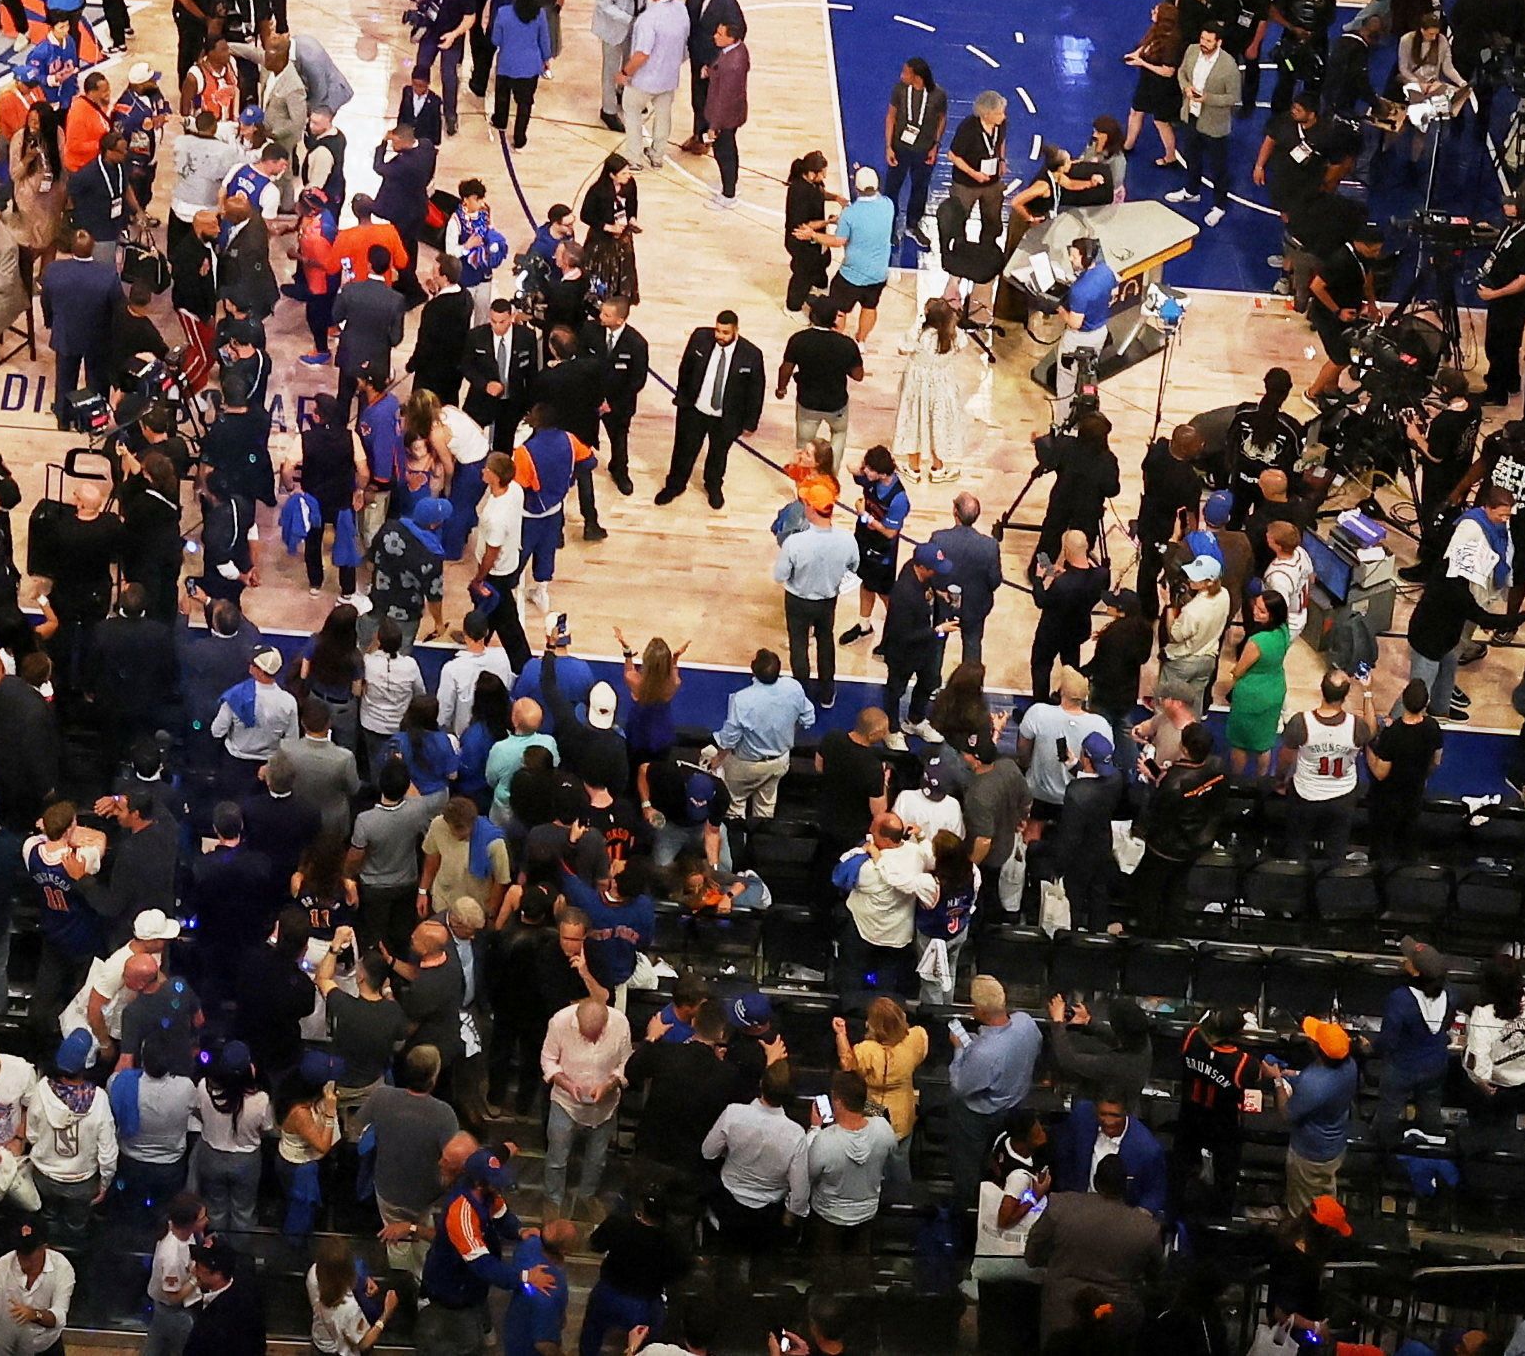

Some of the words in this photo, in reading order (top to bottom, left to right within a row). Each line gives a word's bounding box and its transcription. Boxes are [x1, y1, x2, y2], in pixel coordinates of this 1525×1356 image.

[1318, 756, 1344, 779] 11
[43, 886, 69, 913] 11
[310, 908, 333, 928] 11
[1186, 1058, 1232, 1089] BRUNSON
[1190, 1077, 1216, 1109] 11
